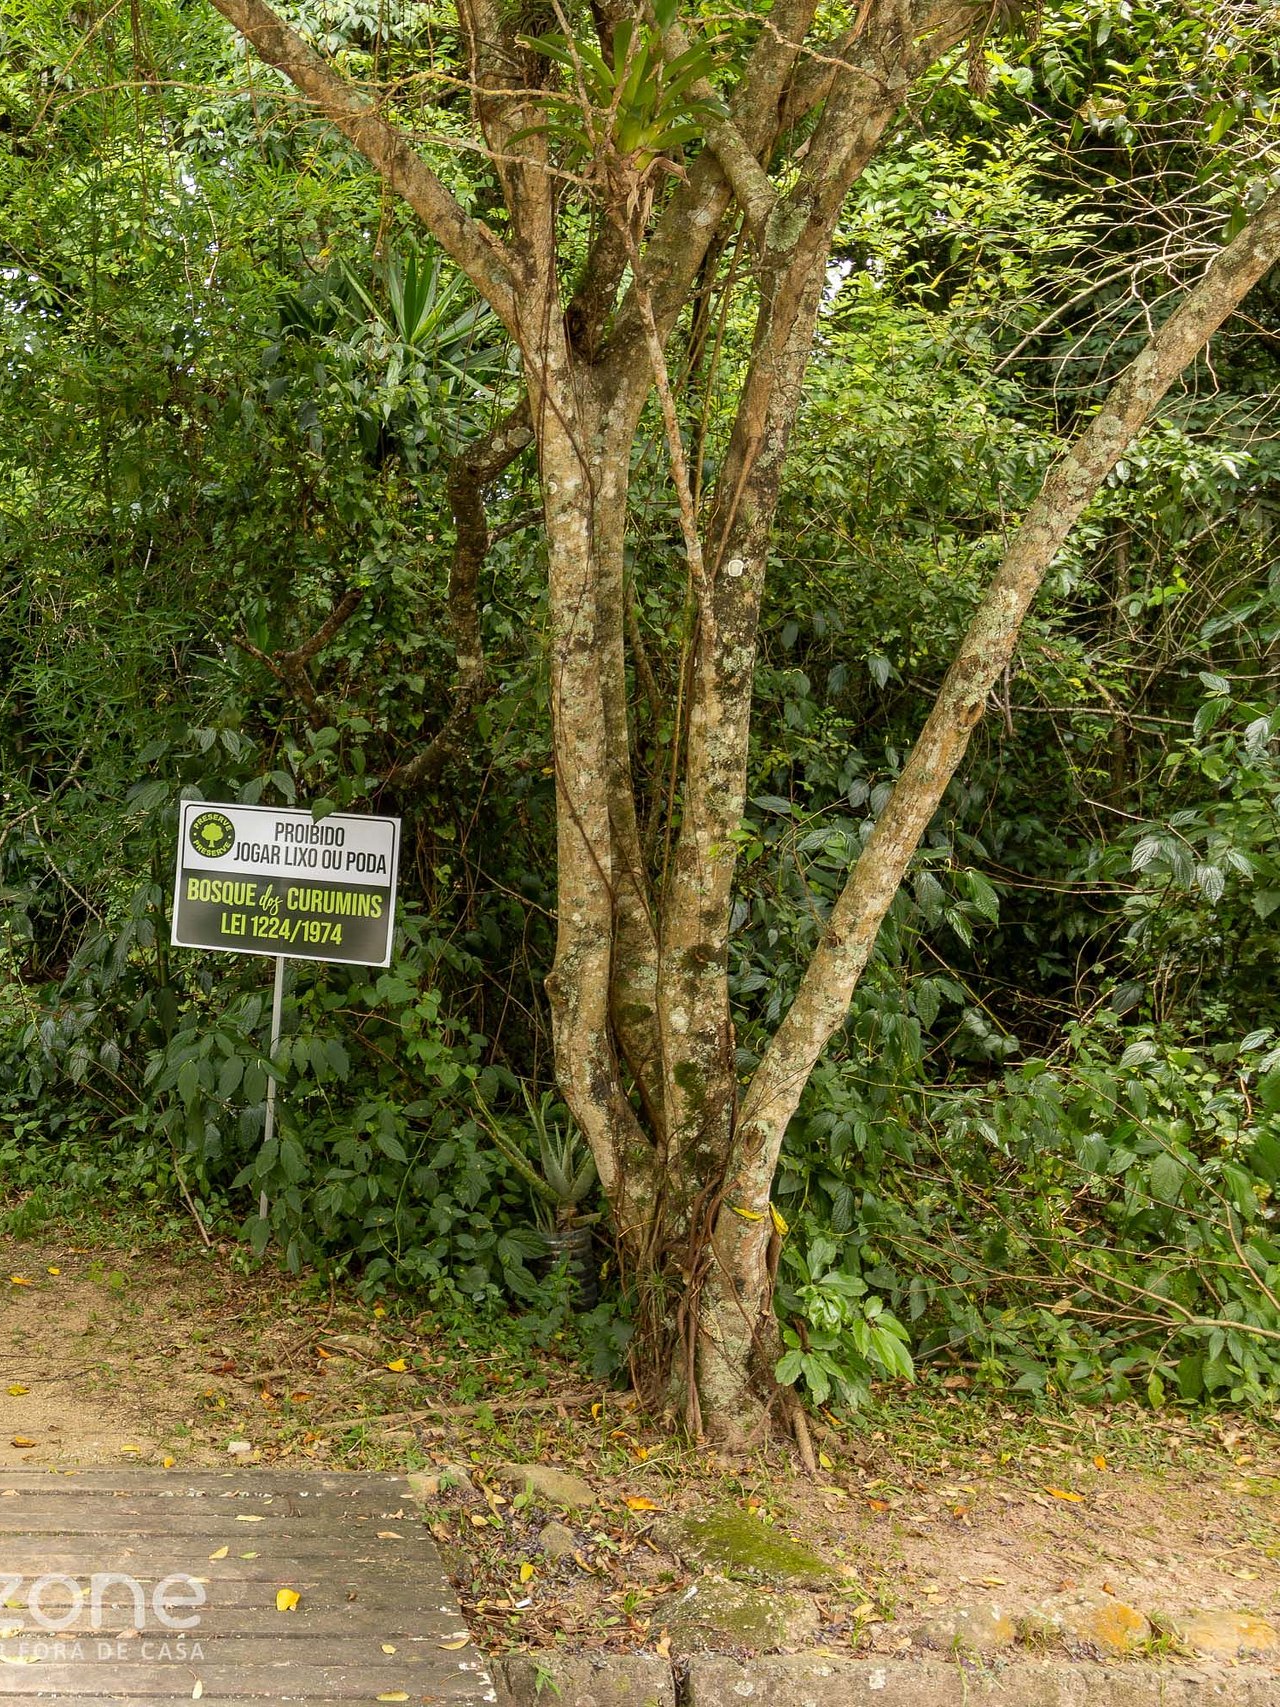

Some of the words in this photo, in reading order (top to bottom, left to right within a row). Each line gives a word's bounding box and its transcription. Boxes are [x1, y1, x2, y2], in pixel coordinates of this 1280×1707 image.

[193, 813, 232, 833] PRESERVE
[274, 821, 345, 847] PROIBIDO
[192, 839, 232, 857] PRESERVE
[233, 841, 280, 866] JOGAR
[284, 846, 317, 868] LIXO
[322, 849, 343, 870] OU
[346, 851, 387, 875] PODA
[187, 877, 257, 908] BOSQUE
[258, 883, 283, 916] dos
[287, 887, 383, 919] CURUMINS
[220, 912, 247, 936] LEI
[251, 914, 343, 945] 1224/1974
